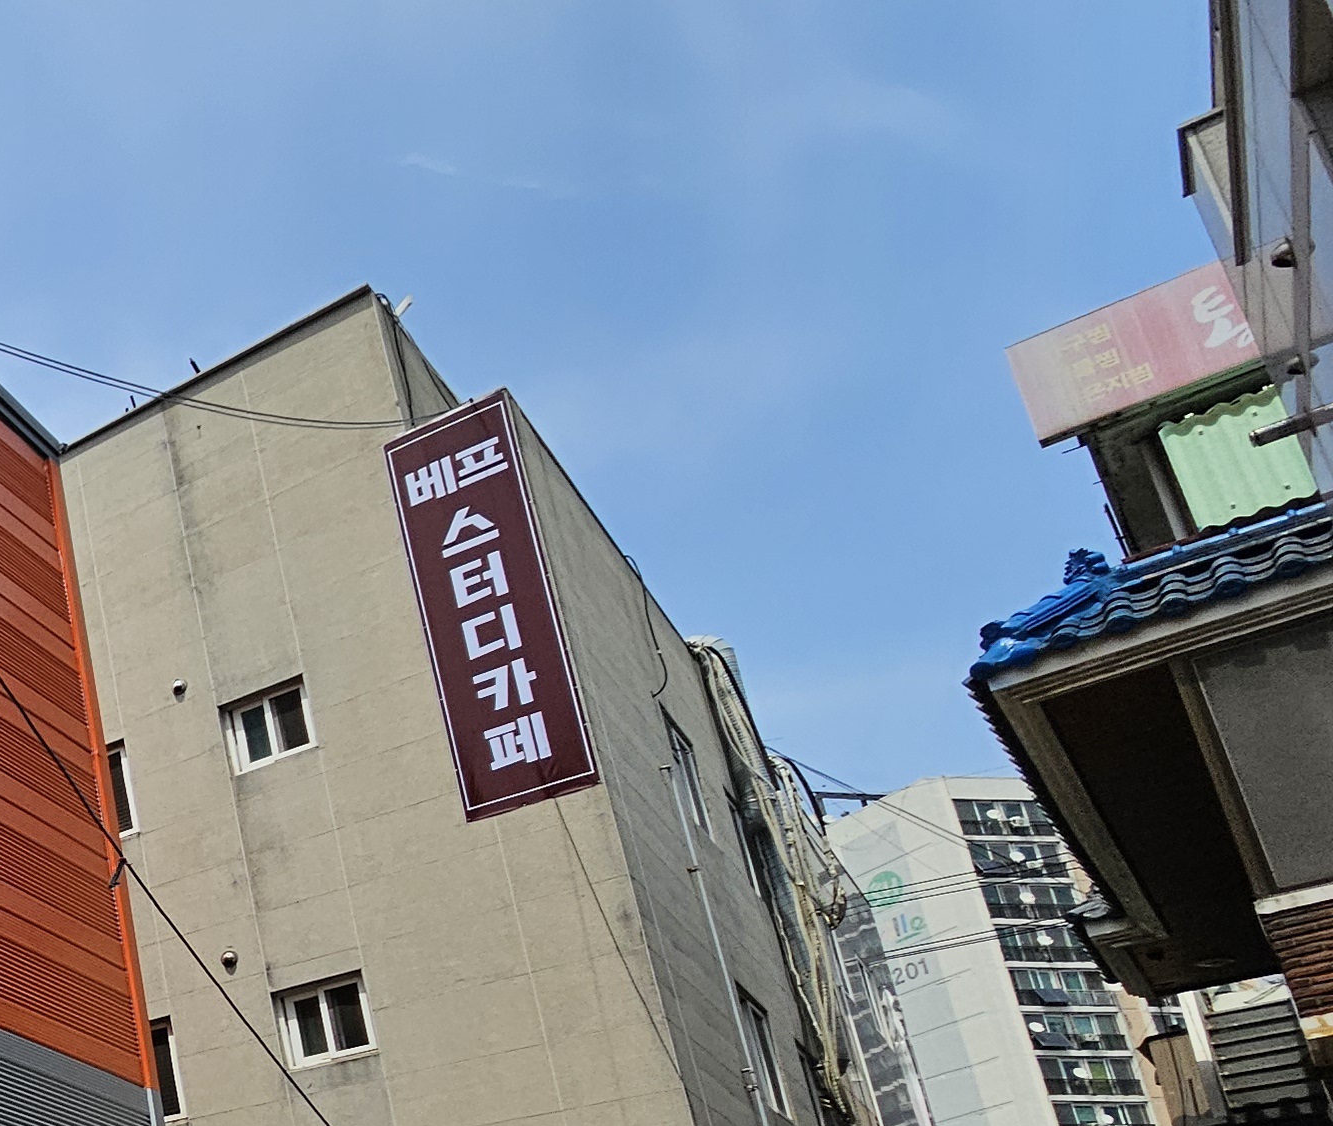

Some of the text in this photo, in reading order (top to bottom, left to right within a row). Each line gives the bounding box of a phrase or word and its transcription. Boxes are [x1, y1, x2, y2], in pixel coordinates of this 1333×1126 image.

[404, 436, 509, 507] 베프
[442, 505, 553, 772] 스터디카페
[892, 957, 929, 987] 201
